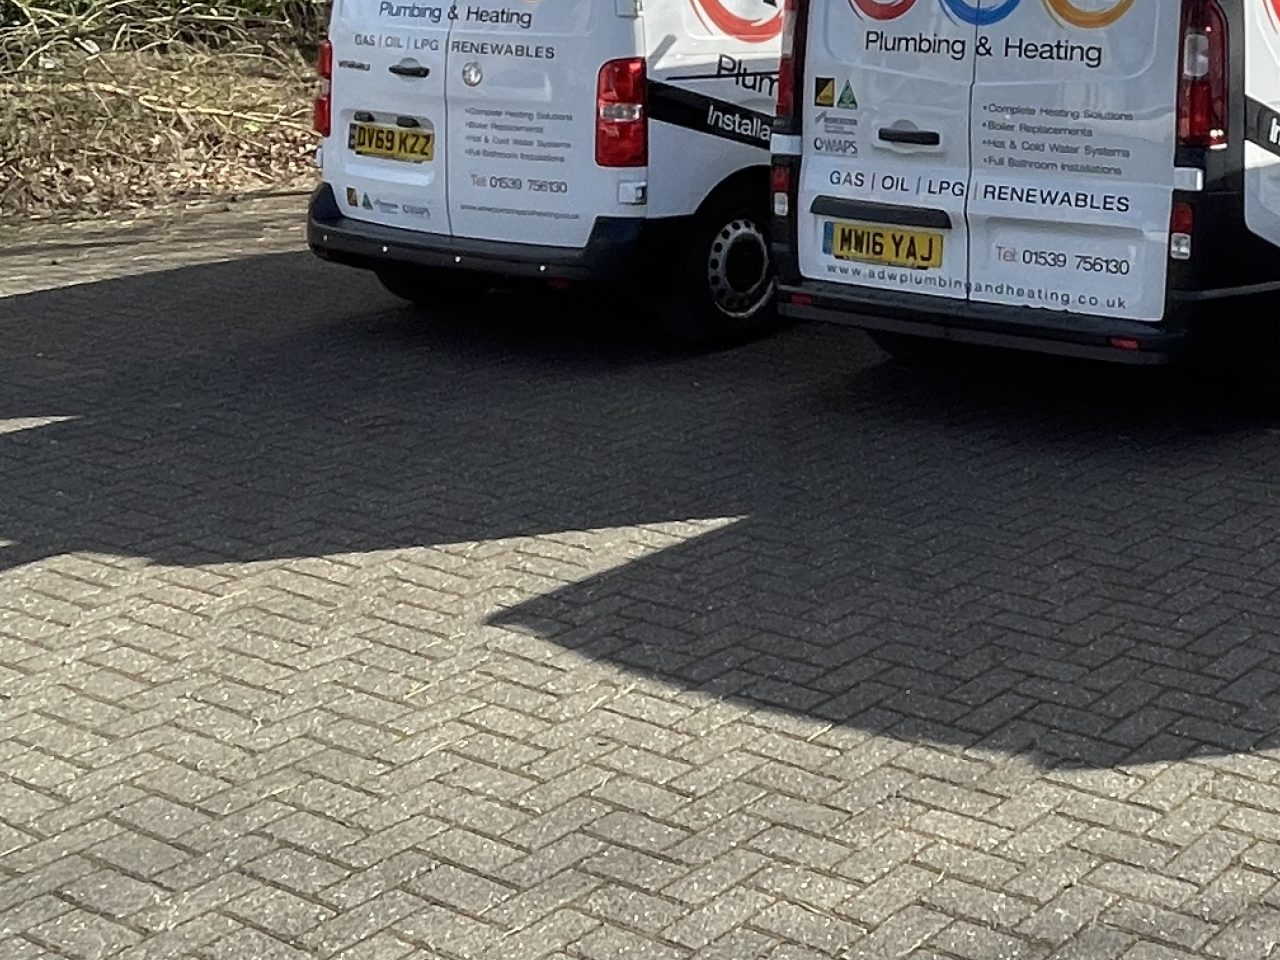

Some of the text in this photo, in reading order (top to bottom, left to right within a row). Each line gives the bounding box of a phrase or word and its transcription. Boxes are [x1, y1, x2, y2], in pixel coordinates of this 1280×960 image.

[379, 1, 531, 29] Plumbing & Heating
[355, 34, 376, 46] GAS
[414, 38, 439, 51] LPG
[451, 41, 555, 59] RENEWABLES
[865, 31, 1102, 68] Plumbing & Heating
[356, 126, 431, 156] DV69 KZZ
[830, 171, 1130, 212] GAS OIL LPG RENEWABLES
[840, 227, 933, 261] MW16 YAJ
[1022, 250, 1067, 267] 01539
[1074, 255, 1129, 275] 756130
